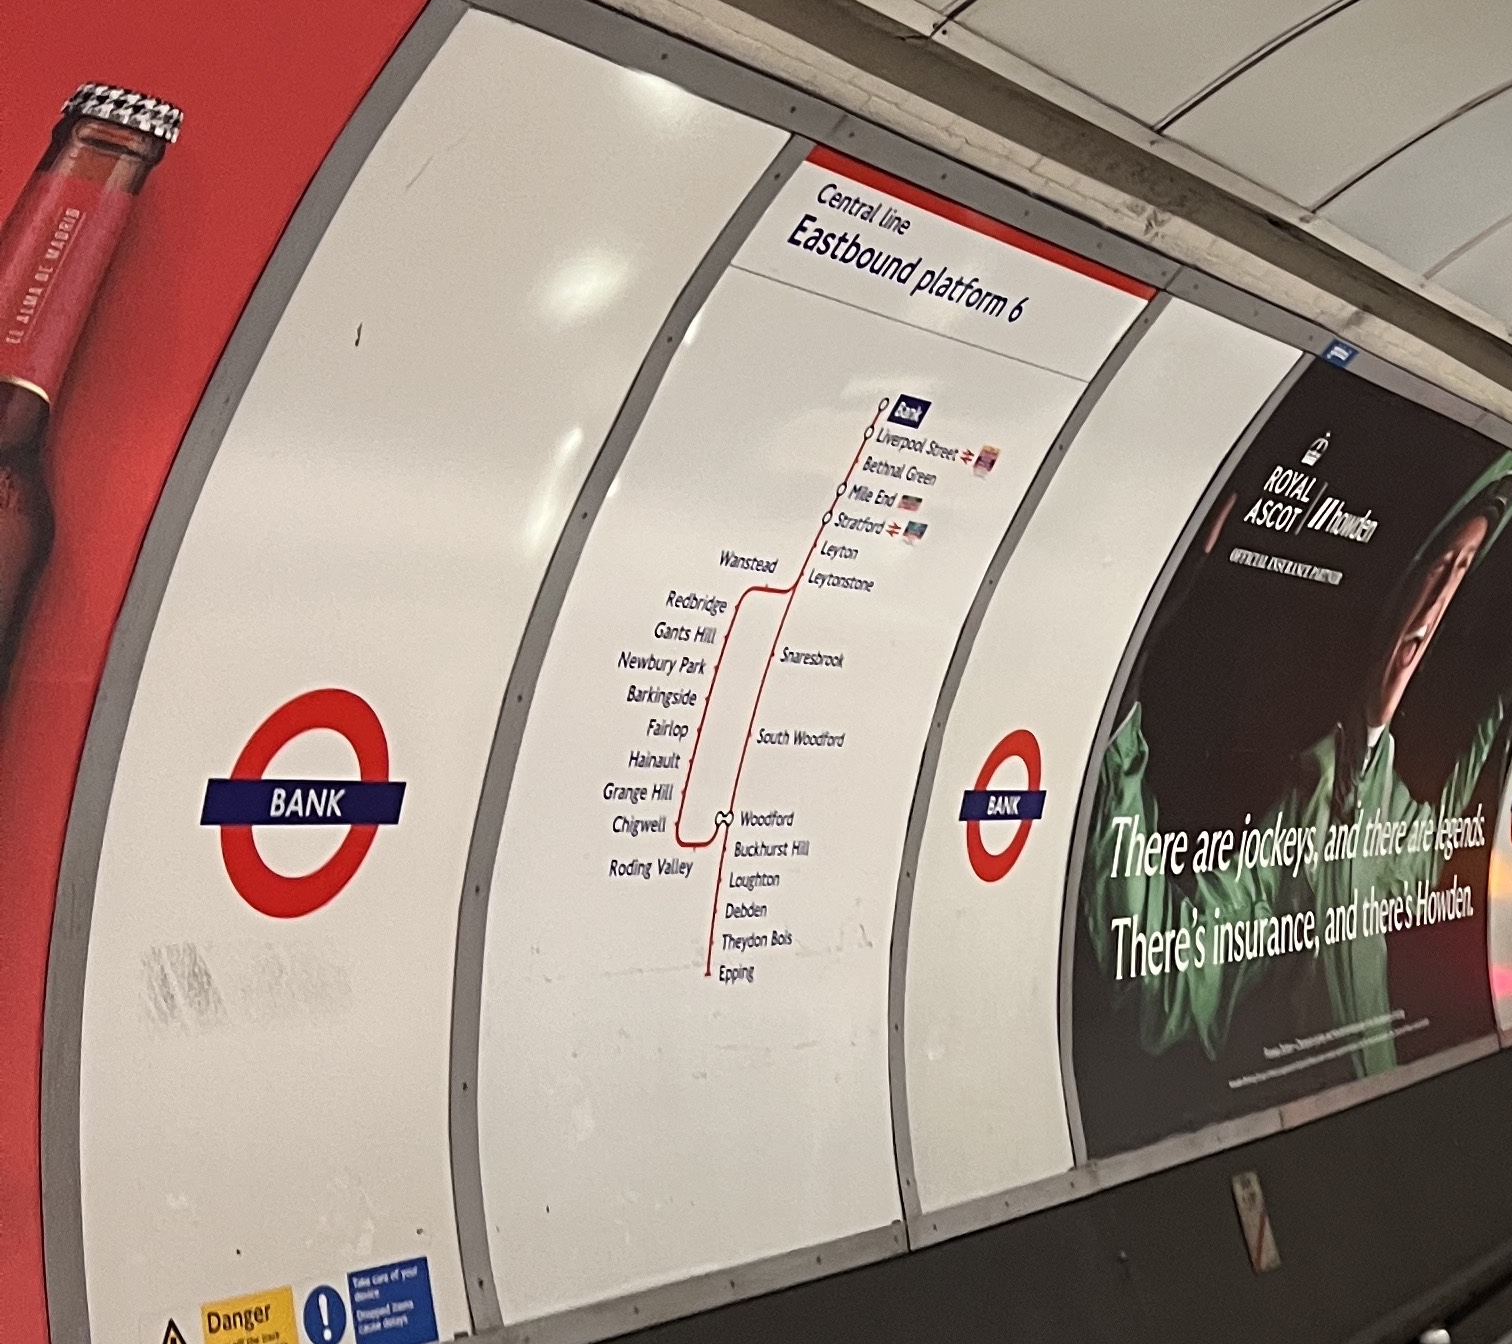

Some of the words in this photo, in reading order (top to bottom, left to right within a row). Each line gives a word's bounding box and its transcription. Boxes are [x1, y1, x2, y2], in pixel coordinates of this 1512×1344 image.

[817, 183, 877, 224] Central
[880, 207, 911, 236] line
[787, 213, 922, 285] Eastbound
[910, 267, 1008, 319] platform
[1007, 297, 1030, 323] 6
[894, 401, 922, 422] Bank
[876, 428, 927, 453] Liverpool
[926, 440, 958, 461] Street
[863, 456, 905, 479] Bethnal
[906, 466, 937, 486] Green
[1264, 465, 1318, 503] ROYAL
[848, 484, 873, 503] Mile
[875, 490, 898, 507] End
[834, 512, 885, 535] Stratford
[1244, 498, 1302, 534] ASCOT
[820, 540, 859, 560] Leyton
[719, 550, 778, 574] Wanstead
[808, 568, 874, 592] Leytonstone
[666, 591, 728, 614] Redbridge
[654, 622, 691, 642] Gants
[693, 626, 716, 644] Hill
[618, 652, 676, 675] Newbury
[679, 656, 706, 675] Park
[779, 647, 844, 669] Snaresbrook
[627, 685, 697, 708] Barkingside
[646, 720, 689, 740] Fairlop
[757, 727, 790, 746] South
[793, 730, 845, 748] Woodford
[628, 751, 680, 770] Hainault
[269, 787, 346, 818] BANK
[603, 782, 647, 803] Grange
[651, 782, 673, 801] Hill
[986, 795, 1021, 816] BANK
[612, 815, 666, 835] Chigwell
[740, 810, 794, 828] Woodford
[734, 840, 788, 858] Buckhurst
[791, 840, 810, 856] Hill
[1111, 815, 1188, 878] There
[1192, 828, 1236, 875] are
[1234, 812, 1318, 883] jockeys,
[1323, 802, 1362, 862] and
[1363, 809, 1406, 858] there
[1406, 819, 1433, 852] are
[609, 858, 652, 878] Roding
[657, 858, 693, 877] Valley
[729, 870, 780, 890] Loughton
[725, 901, 767, 920] Debden
[1212, 907, 1320, 965] insurance,
[1325, 889, 1358, 944] and
[1415, 874, 1475, 927] Howden.
[722, 932, 767, 952] Theydon
[770, 931, 792, 948] Bois
[718, 963, 755, 984] Epping
[207, 1303, 271, 1334] Danger
